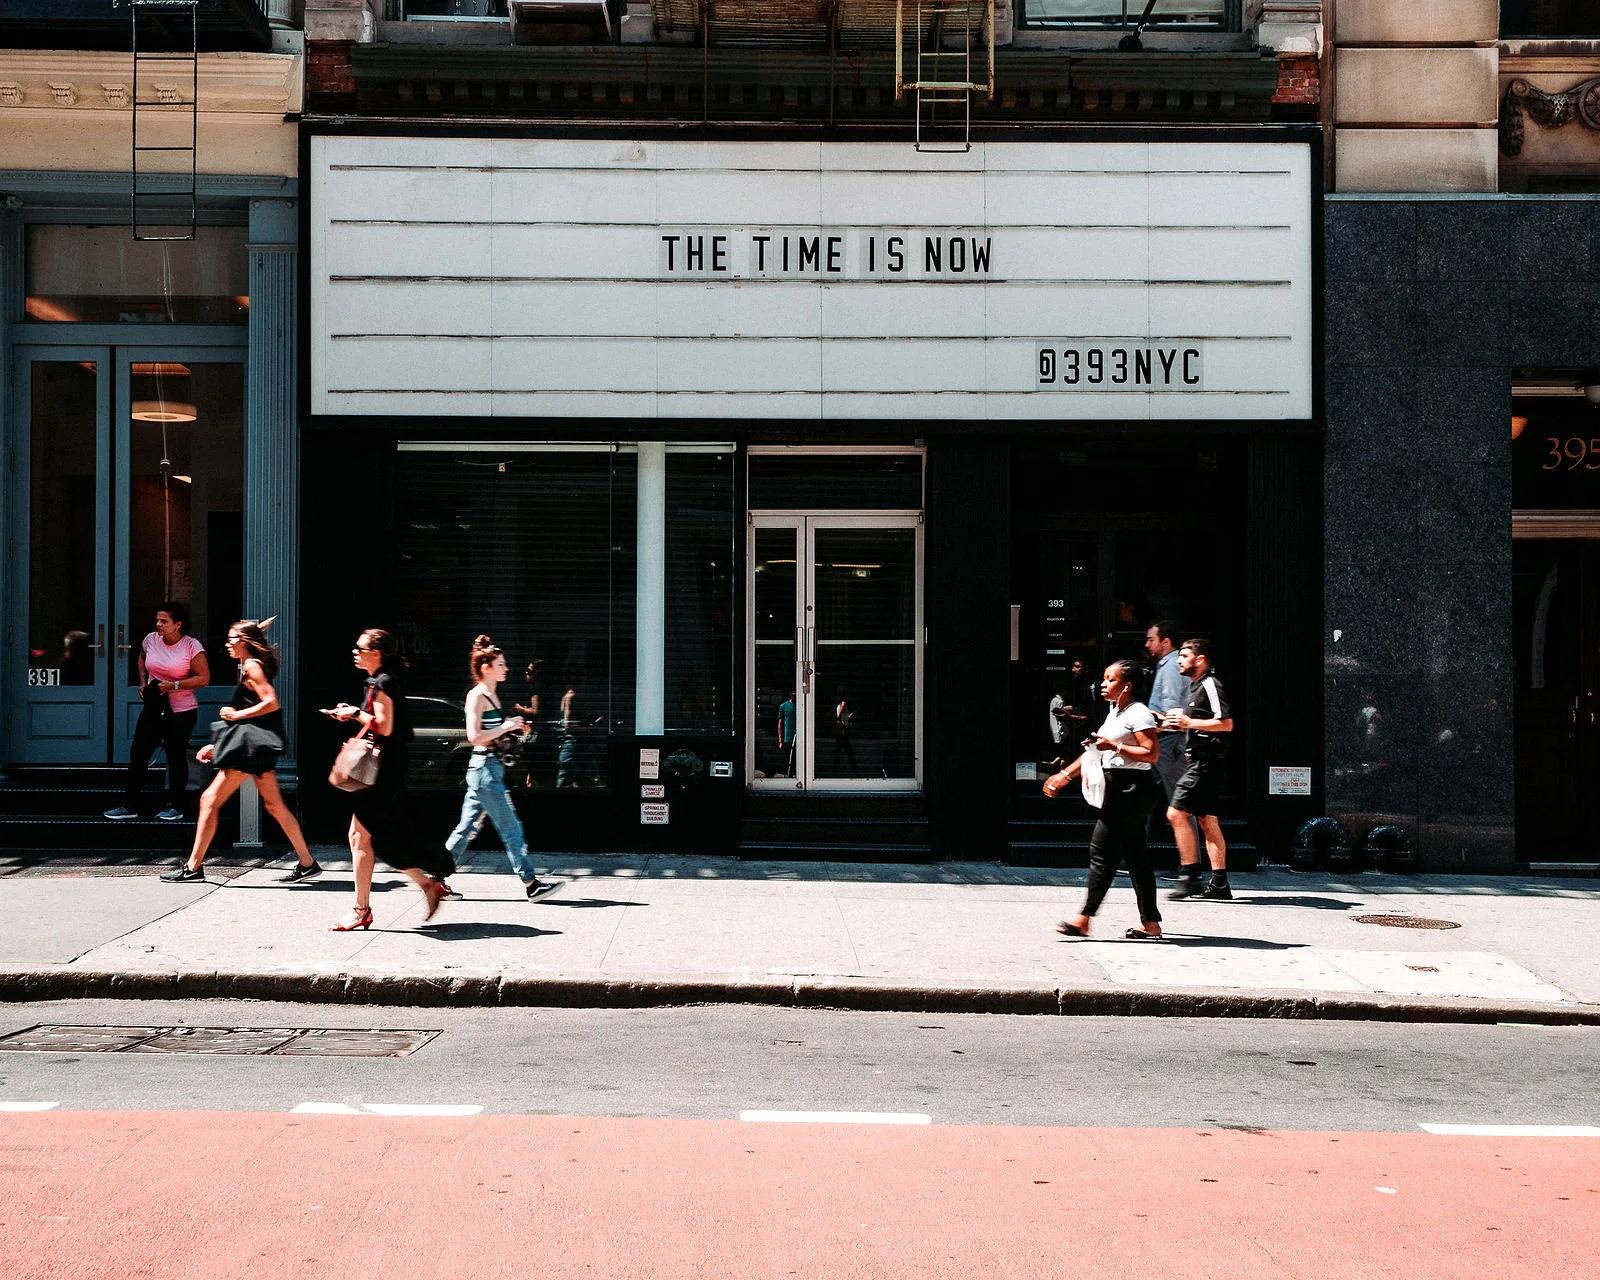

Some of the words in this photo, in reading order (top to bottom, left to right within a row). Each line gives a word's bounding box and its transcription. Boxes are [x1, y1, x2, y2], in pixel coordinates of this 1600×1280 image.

[662, 236, 727, 271] THE
[752, 236, 842, 272] TIME
[869, 237, 904, 272] IS
[925, 237, 991, 272] NOW
[1039, 349, 1199, 384] @393NYC
[1542, 437, 1600, 471] 395
[1048, 599, 1064, 608] 393
[29, 669, 59, 686] 391
